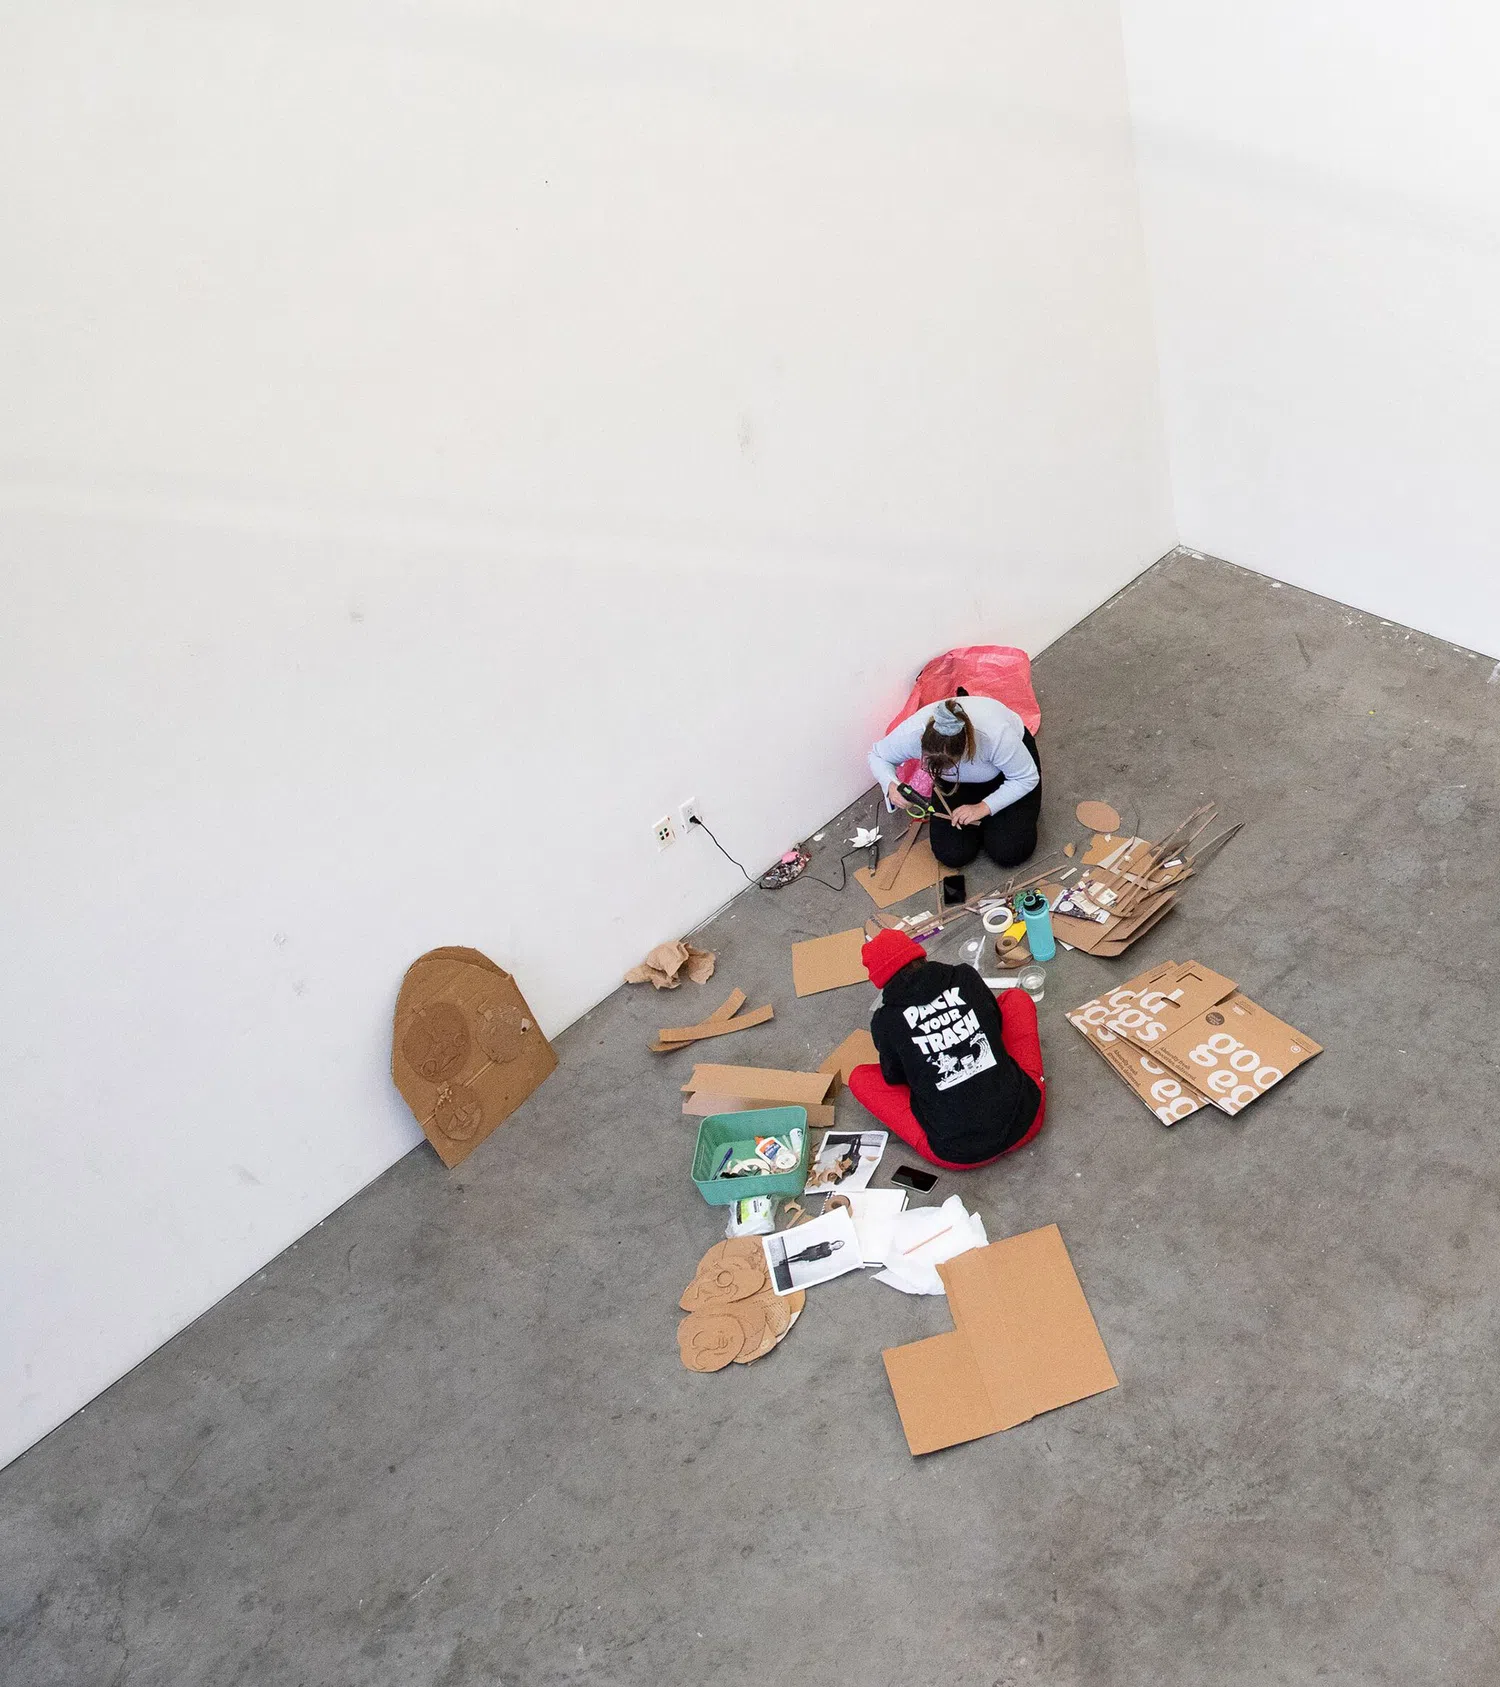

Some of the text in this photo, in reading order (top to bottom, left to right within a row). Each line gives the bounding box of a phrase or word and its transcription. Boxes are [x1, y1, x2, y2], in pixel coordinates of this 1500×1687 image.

[902, 986, 966, 1030] PACK
[918, 1008, 962, 1034] YOUR
[911, 1008, 980, 1055] TRASH
